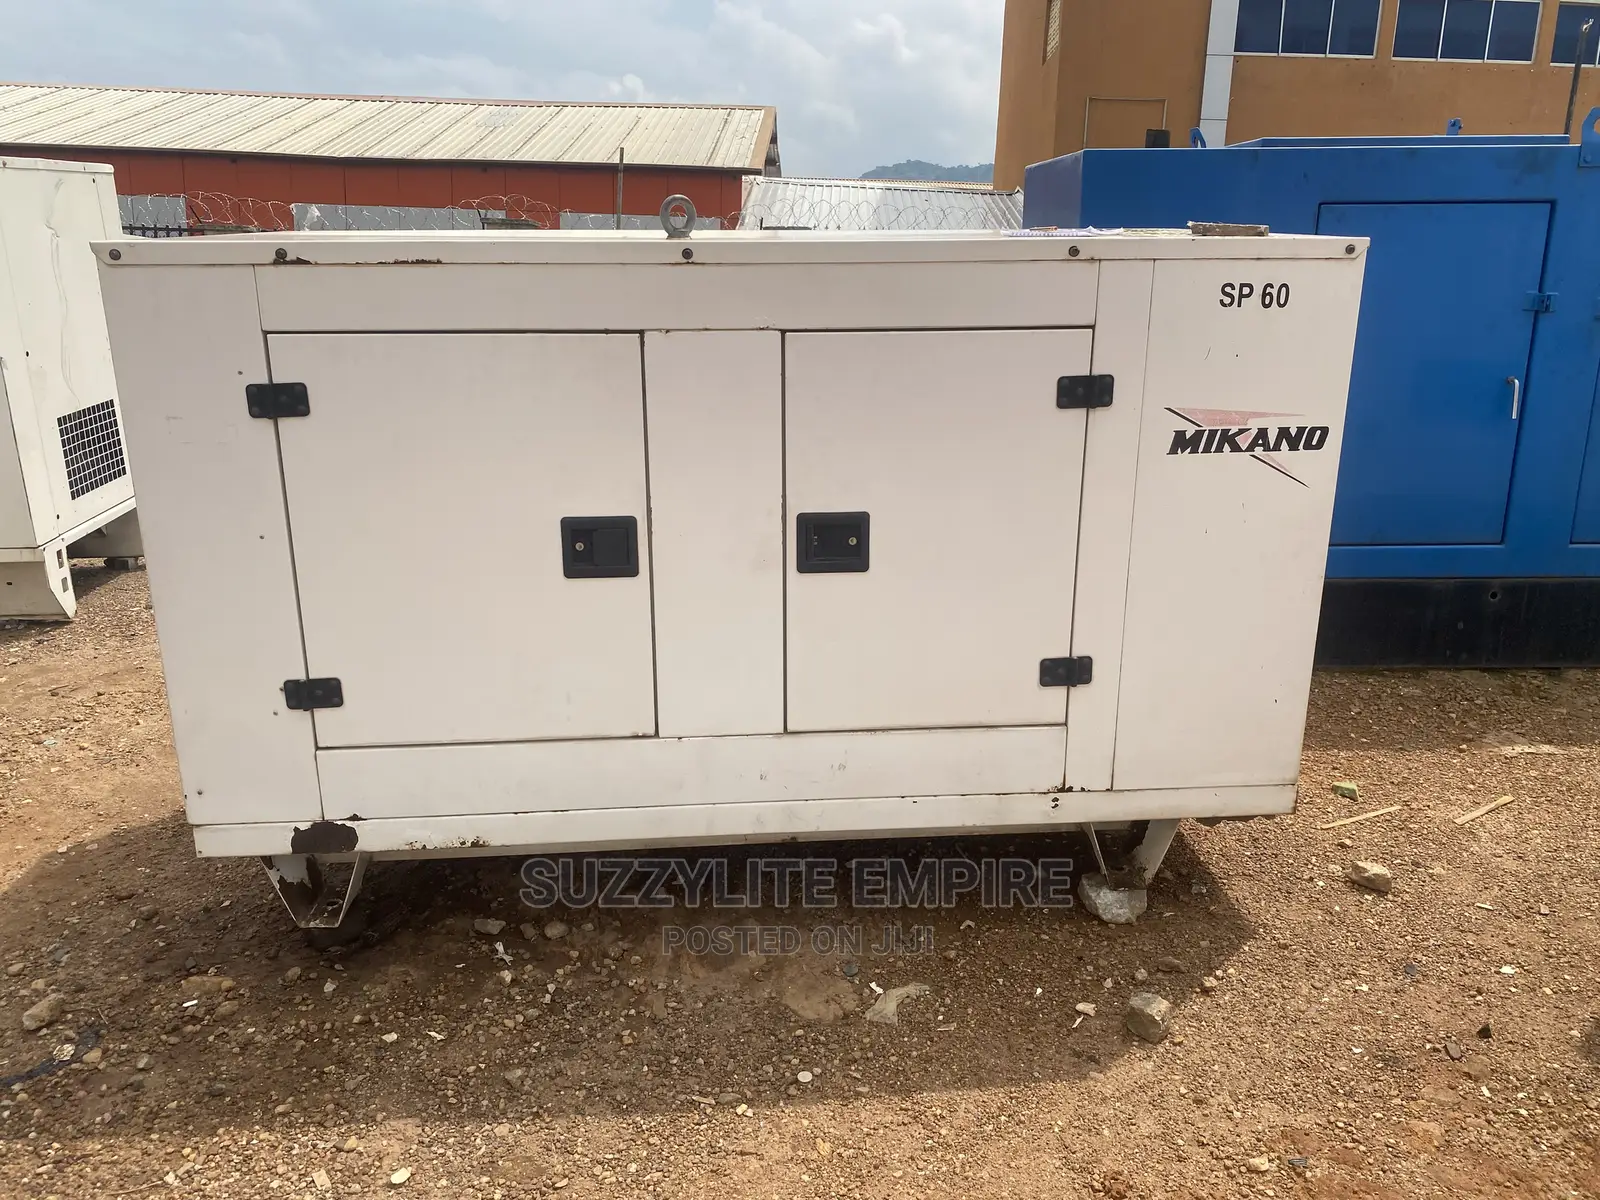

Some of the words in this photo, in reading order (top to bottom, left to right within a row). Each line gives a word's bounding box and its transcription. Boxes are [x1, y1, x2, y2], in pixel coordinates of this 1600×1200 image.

[1219, 282, 1254, 307] SP
[1260, 282, 1290, 308] 60
[1166, 426, 1329, 455] MIKANO
